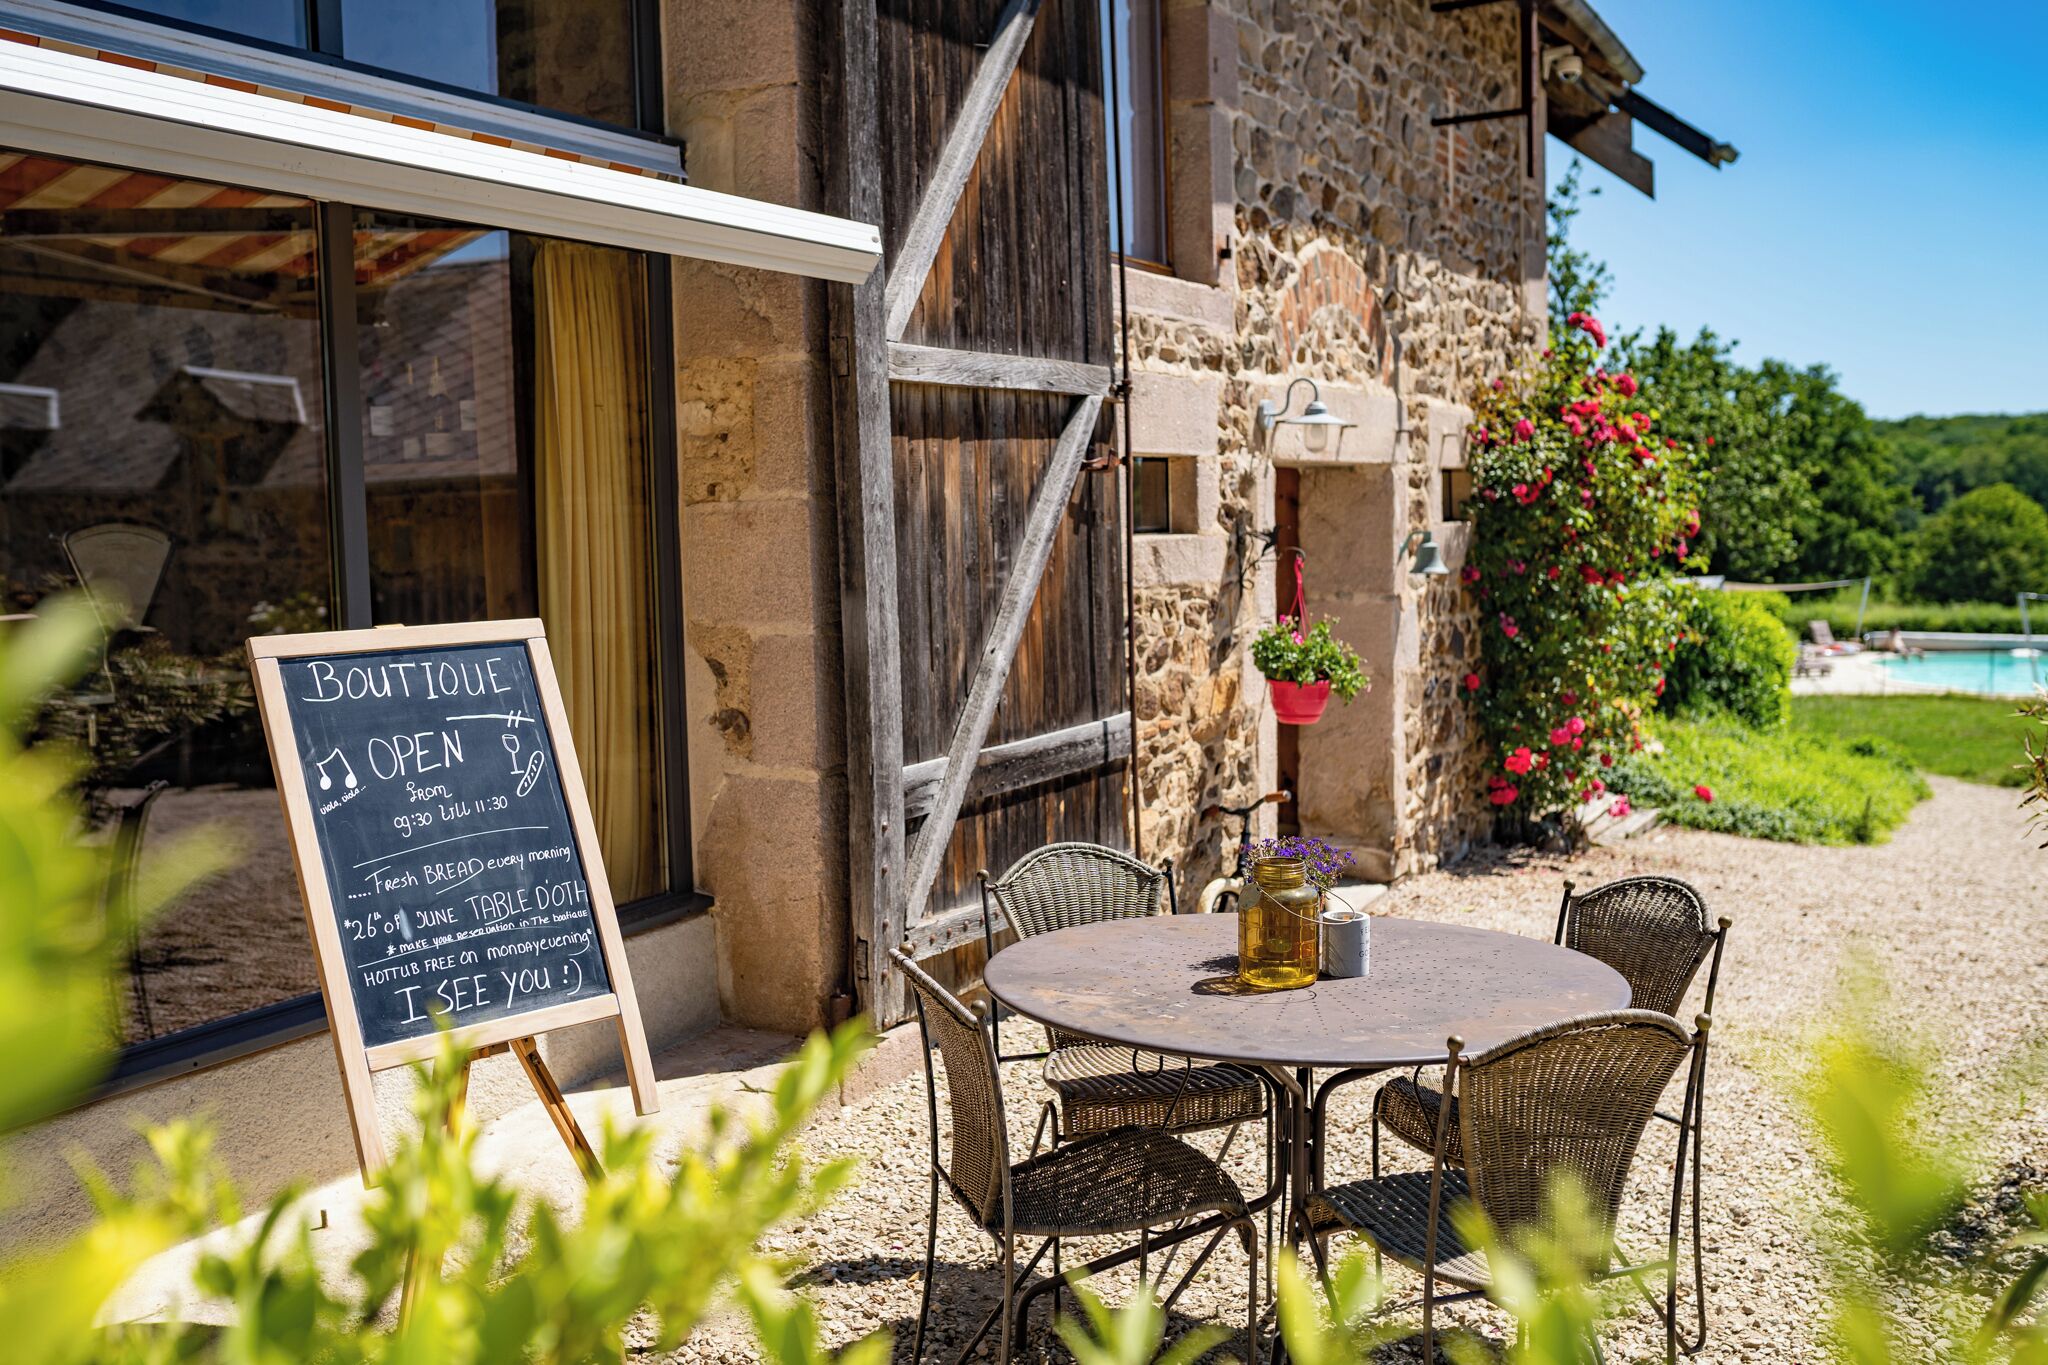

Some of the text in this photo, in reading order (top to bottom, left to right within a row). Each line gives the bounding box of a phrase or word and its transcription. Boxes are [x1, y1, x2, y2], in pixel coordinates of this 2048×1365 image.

[302, 658, 511, 702] BOUTIQUE
[368, 730, 464, 779] OPEN
[393, 811, 433, 838] 09:30
[475, 795, 508, 813] 11:30
[423, 858, 484, 886] BREAD
[416, 908, 459, 929] JUNE
[464, 888, 533, 923] TABLE
[518, 918, 530, 928] in
[364, 962, 420, 987] HOTTUB
[424, 955, 456, 973] FREE
[394, 985, 427, 1025] I
[436, 974, 491, 1015] SEE
[501, 967, 551, 1009] YOU
